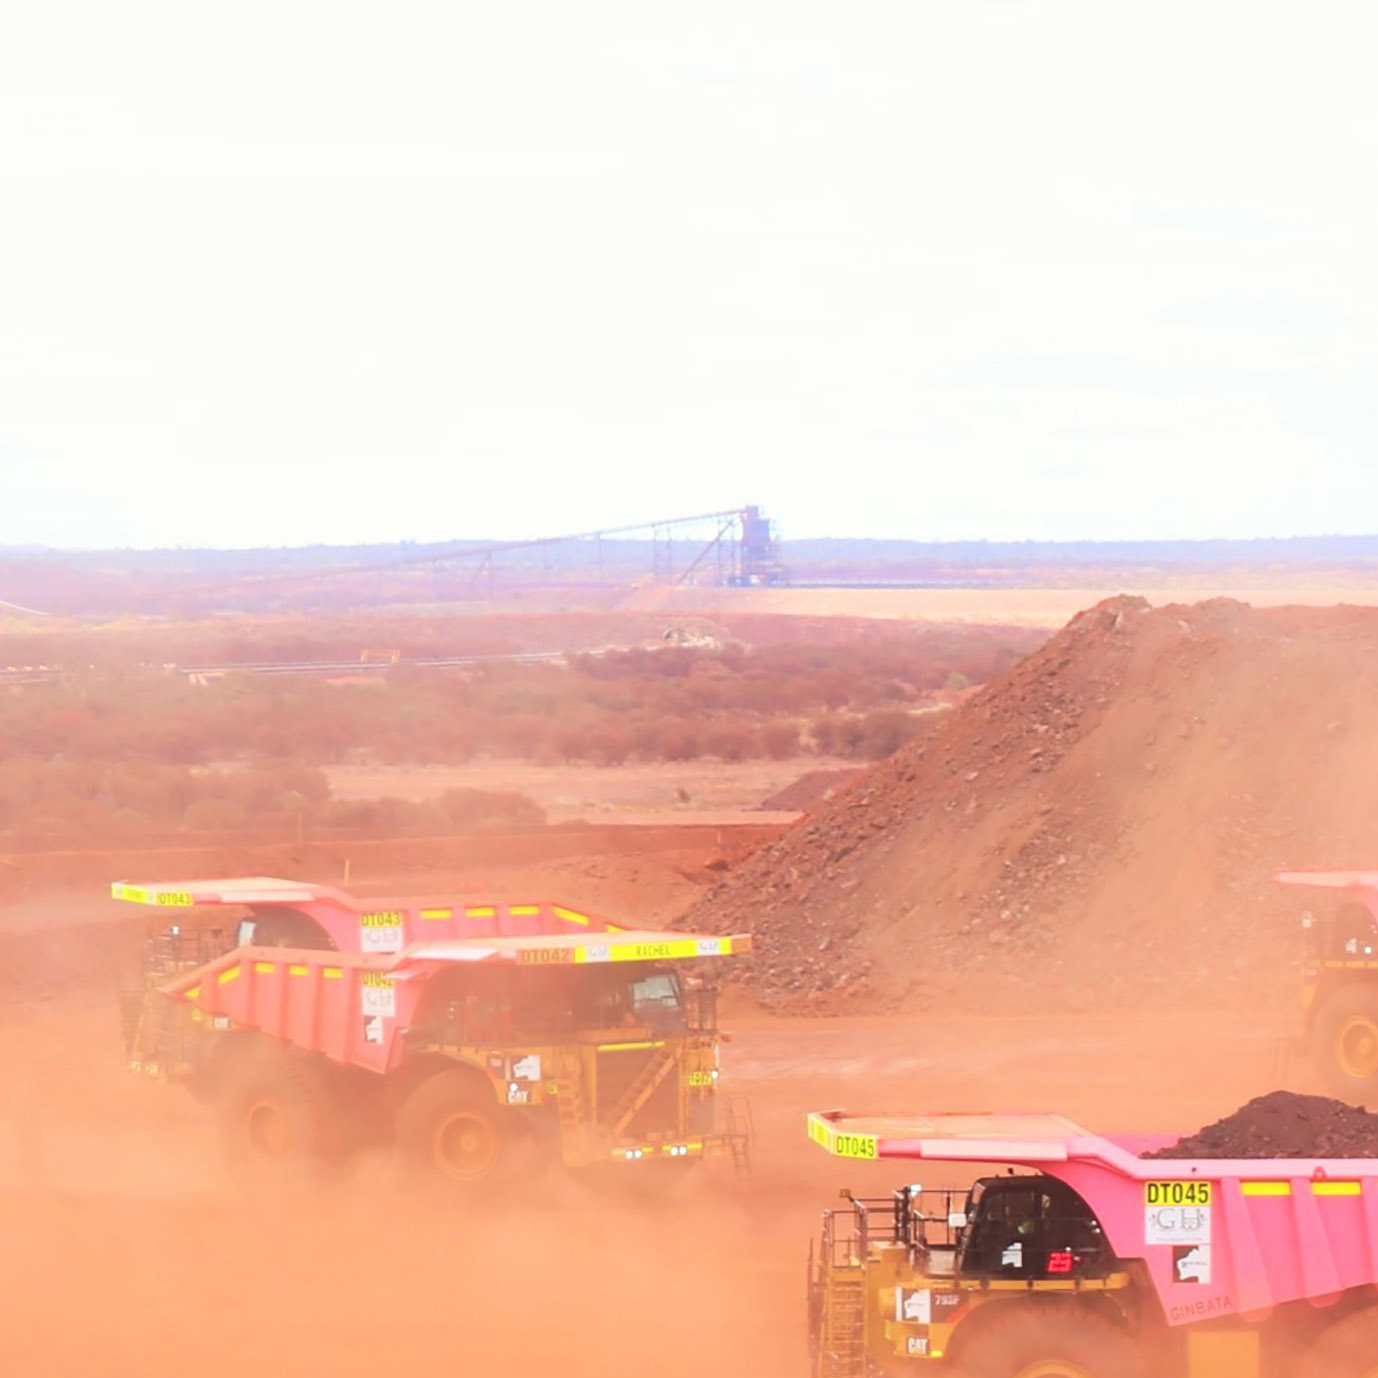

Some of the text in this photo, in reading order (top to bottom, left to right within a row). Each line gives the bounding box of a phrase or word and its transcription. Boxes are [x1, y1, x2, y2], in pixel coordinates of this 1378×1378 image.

[361, 911, 401, 927] DT043
[523, 949, 569, 962] DT042
[636, 944, 671, 957] RACHEL
[836, 1136, 874, 1157] DT045
[1147, 1183, 1209, 1204] DT045
[1170, 1295, 1233, 1321] GINBATA
